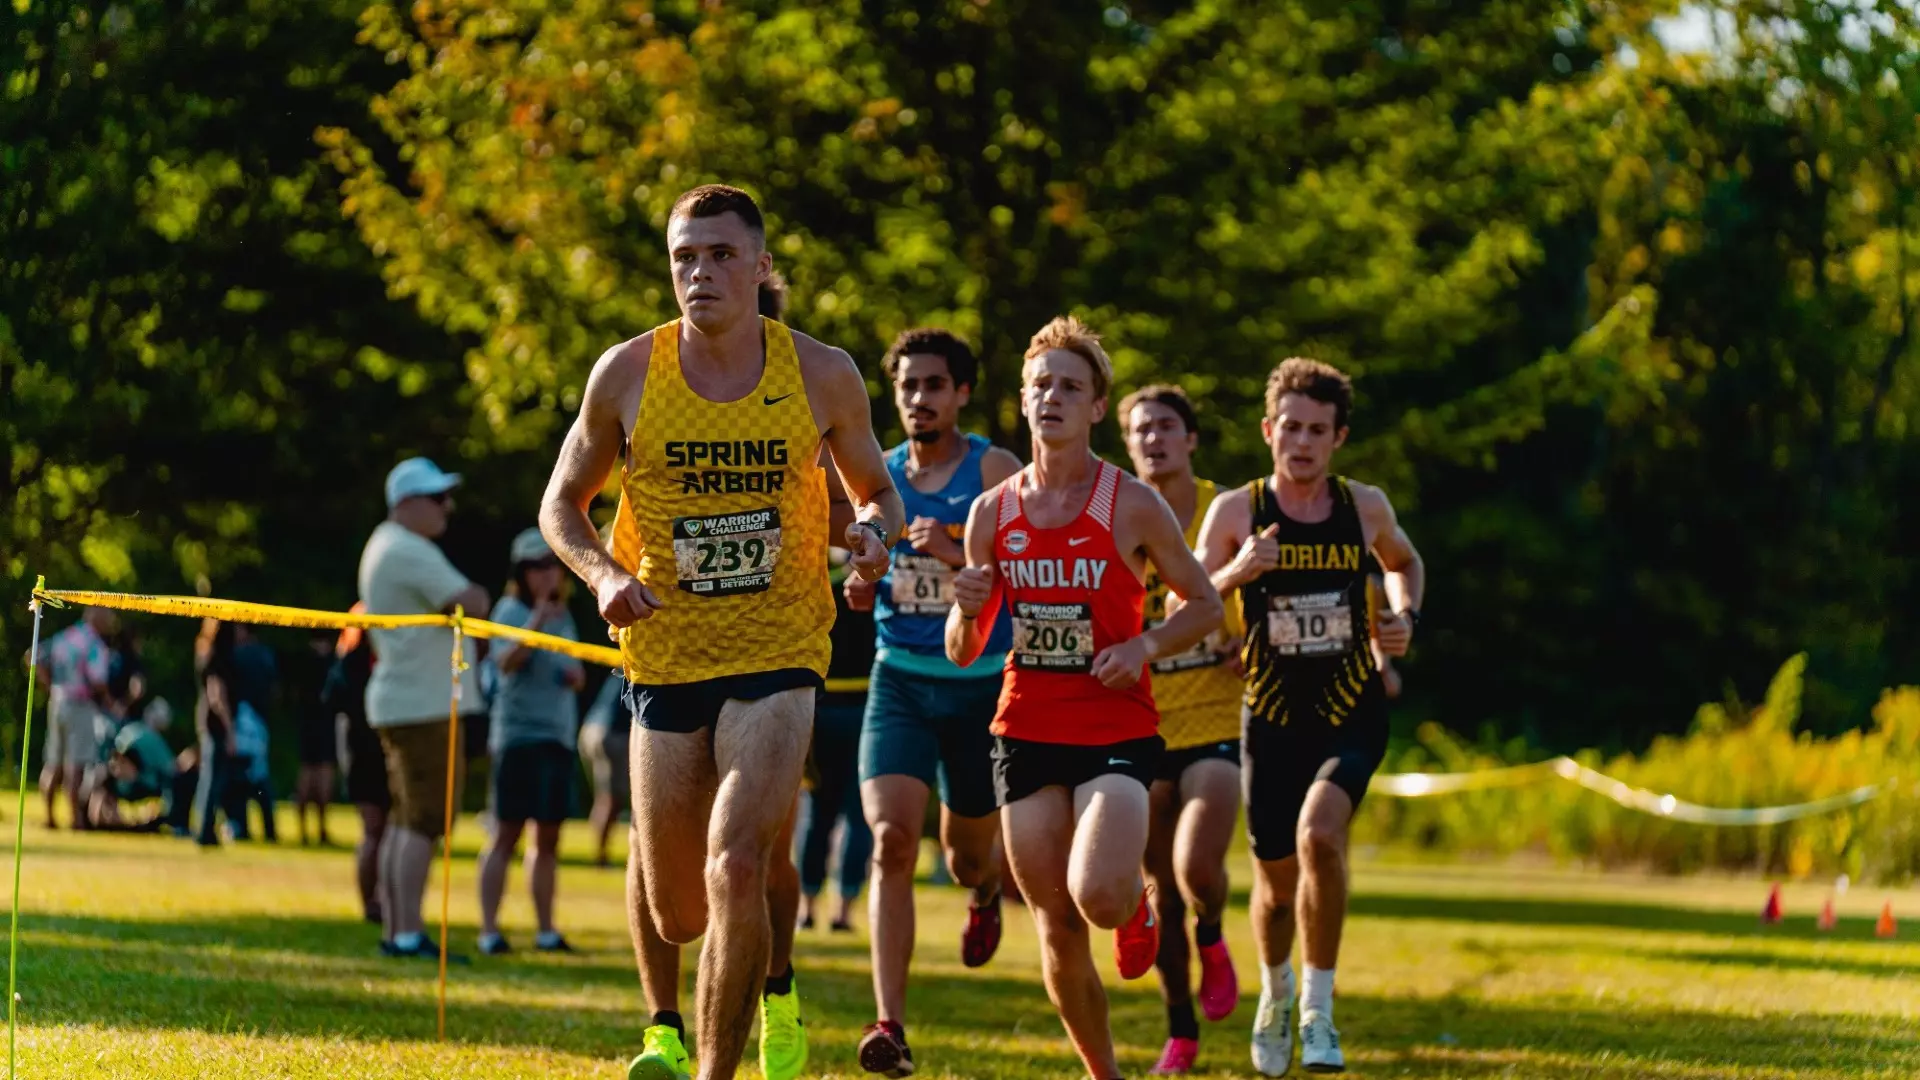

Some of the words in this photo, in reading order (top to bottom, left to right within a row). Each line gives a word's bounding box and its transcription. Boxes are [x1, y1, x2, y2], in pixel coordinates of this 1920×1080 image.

[665, 439, 788, 467] SPRING
[669, 470, 785, 494] ARBOR
[703, 511, 771, 530] WARRIOR
[709, 522, 766, 536] CHALLENGE
[697, 538, 766, 574] 239
[1276, 543, 1360, 572] DRIAN
[720, 579, 763, 589] DETROIT,
[999, 558, 1108, 590] FINDLAY
[914, 576, 940, 599] 61
[1031, 604, 1083, 614] WARRIOR
[1026, 625, 1078, 652] 206
[1296, 614, 1327, 640] 10
